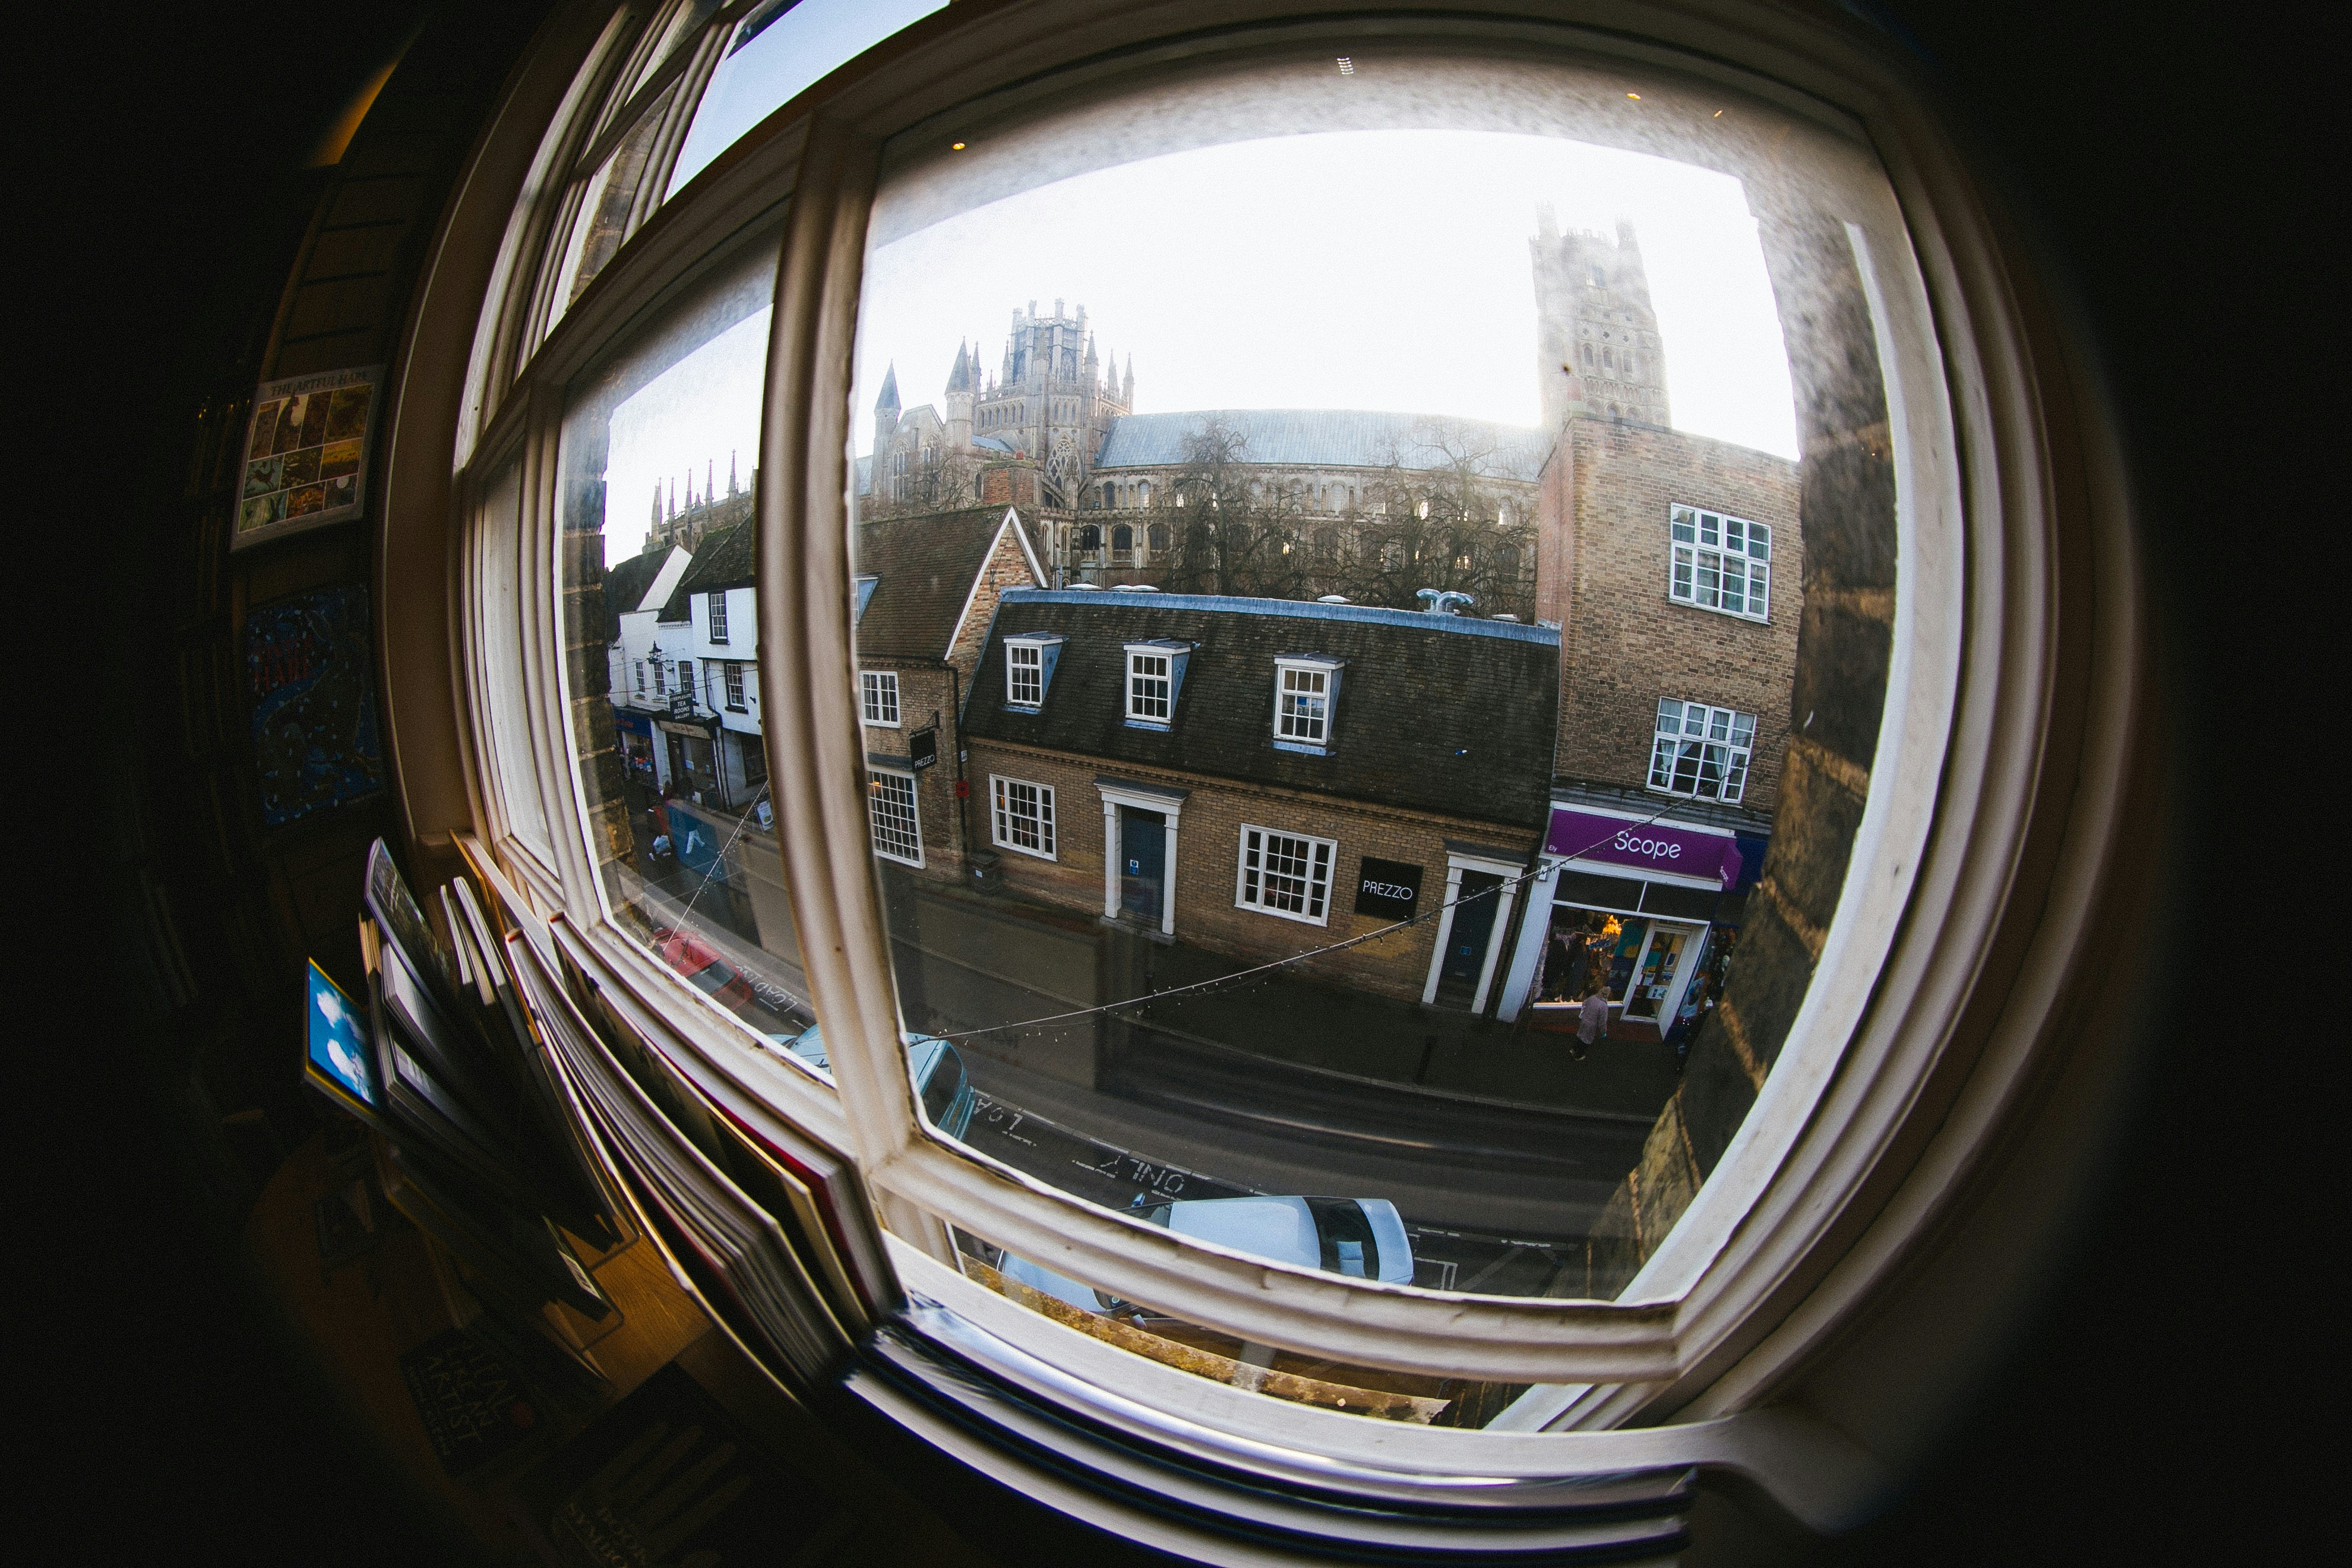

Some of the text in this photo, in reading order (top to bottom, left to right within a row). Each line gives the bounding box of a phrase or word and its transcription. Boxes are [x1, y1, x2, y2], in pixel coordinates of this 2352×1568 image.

[674, 706, 690, 715] ROOMS
[915, 754, 935, 769] PREZZO
[1548, 844, 1558, 853] Ely
[1614, 830, 1681, 859] Scope
[1362, 880, 1413, 900] PREZZO
[426, 1355, 483, 1443] ARTIST
